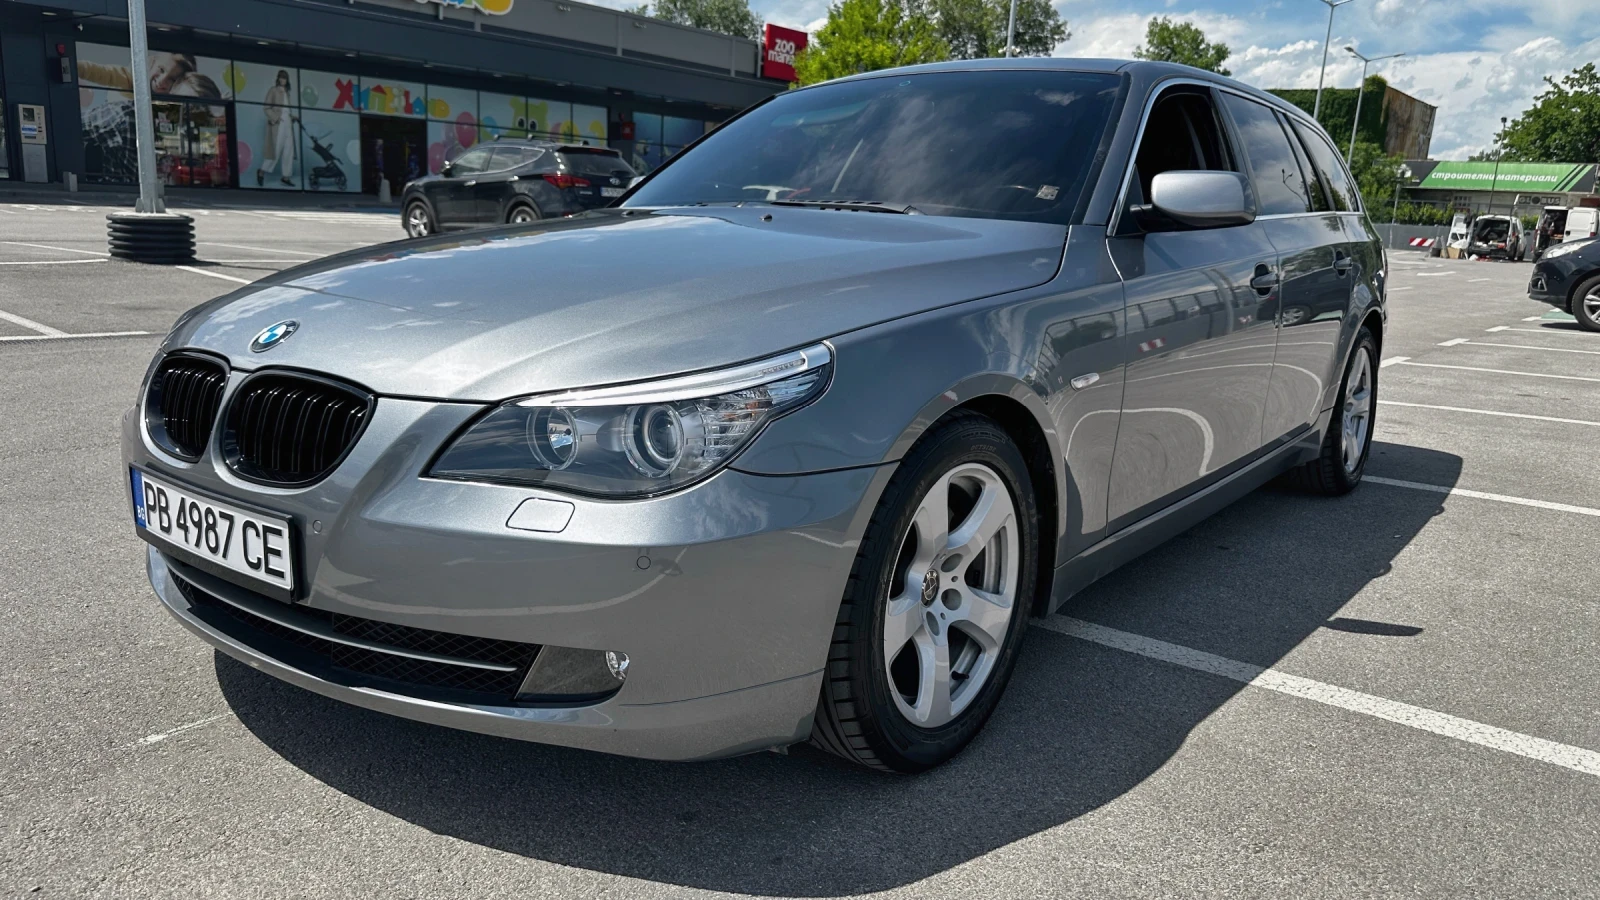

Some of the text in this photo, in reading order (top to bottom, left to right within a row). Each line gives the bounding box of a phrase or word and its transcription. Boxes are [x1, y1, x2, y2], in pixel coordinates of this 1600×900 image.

[1431, 171, 1558, 183] строителни материали
[144, 482, 285, 579] PB 4987 CE
